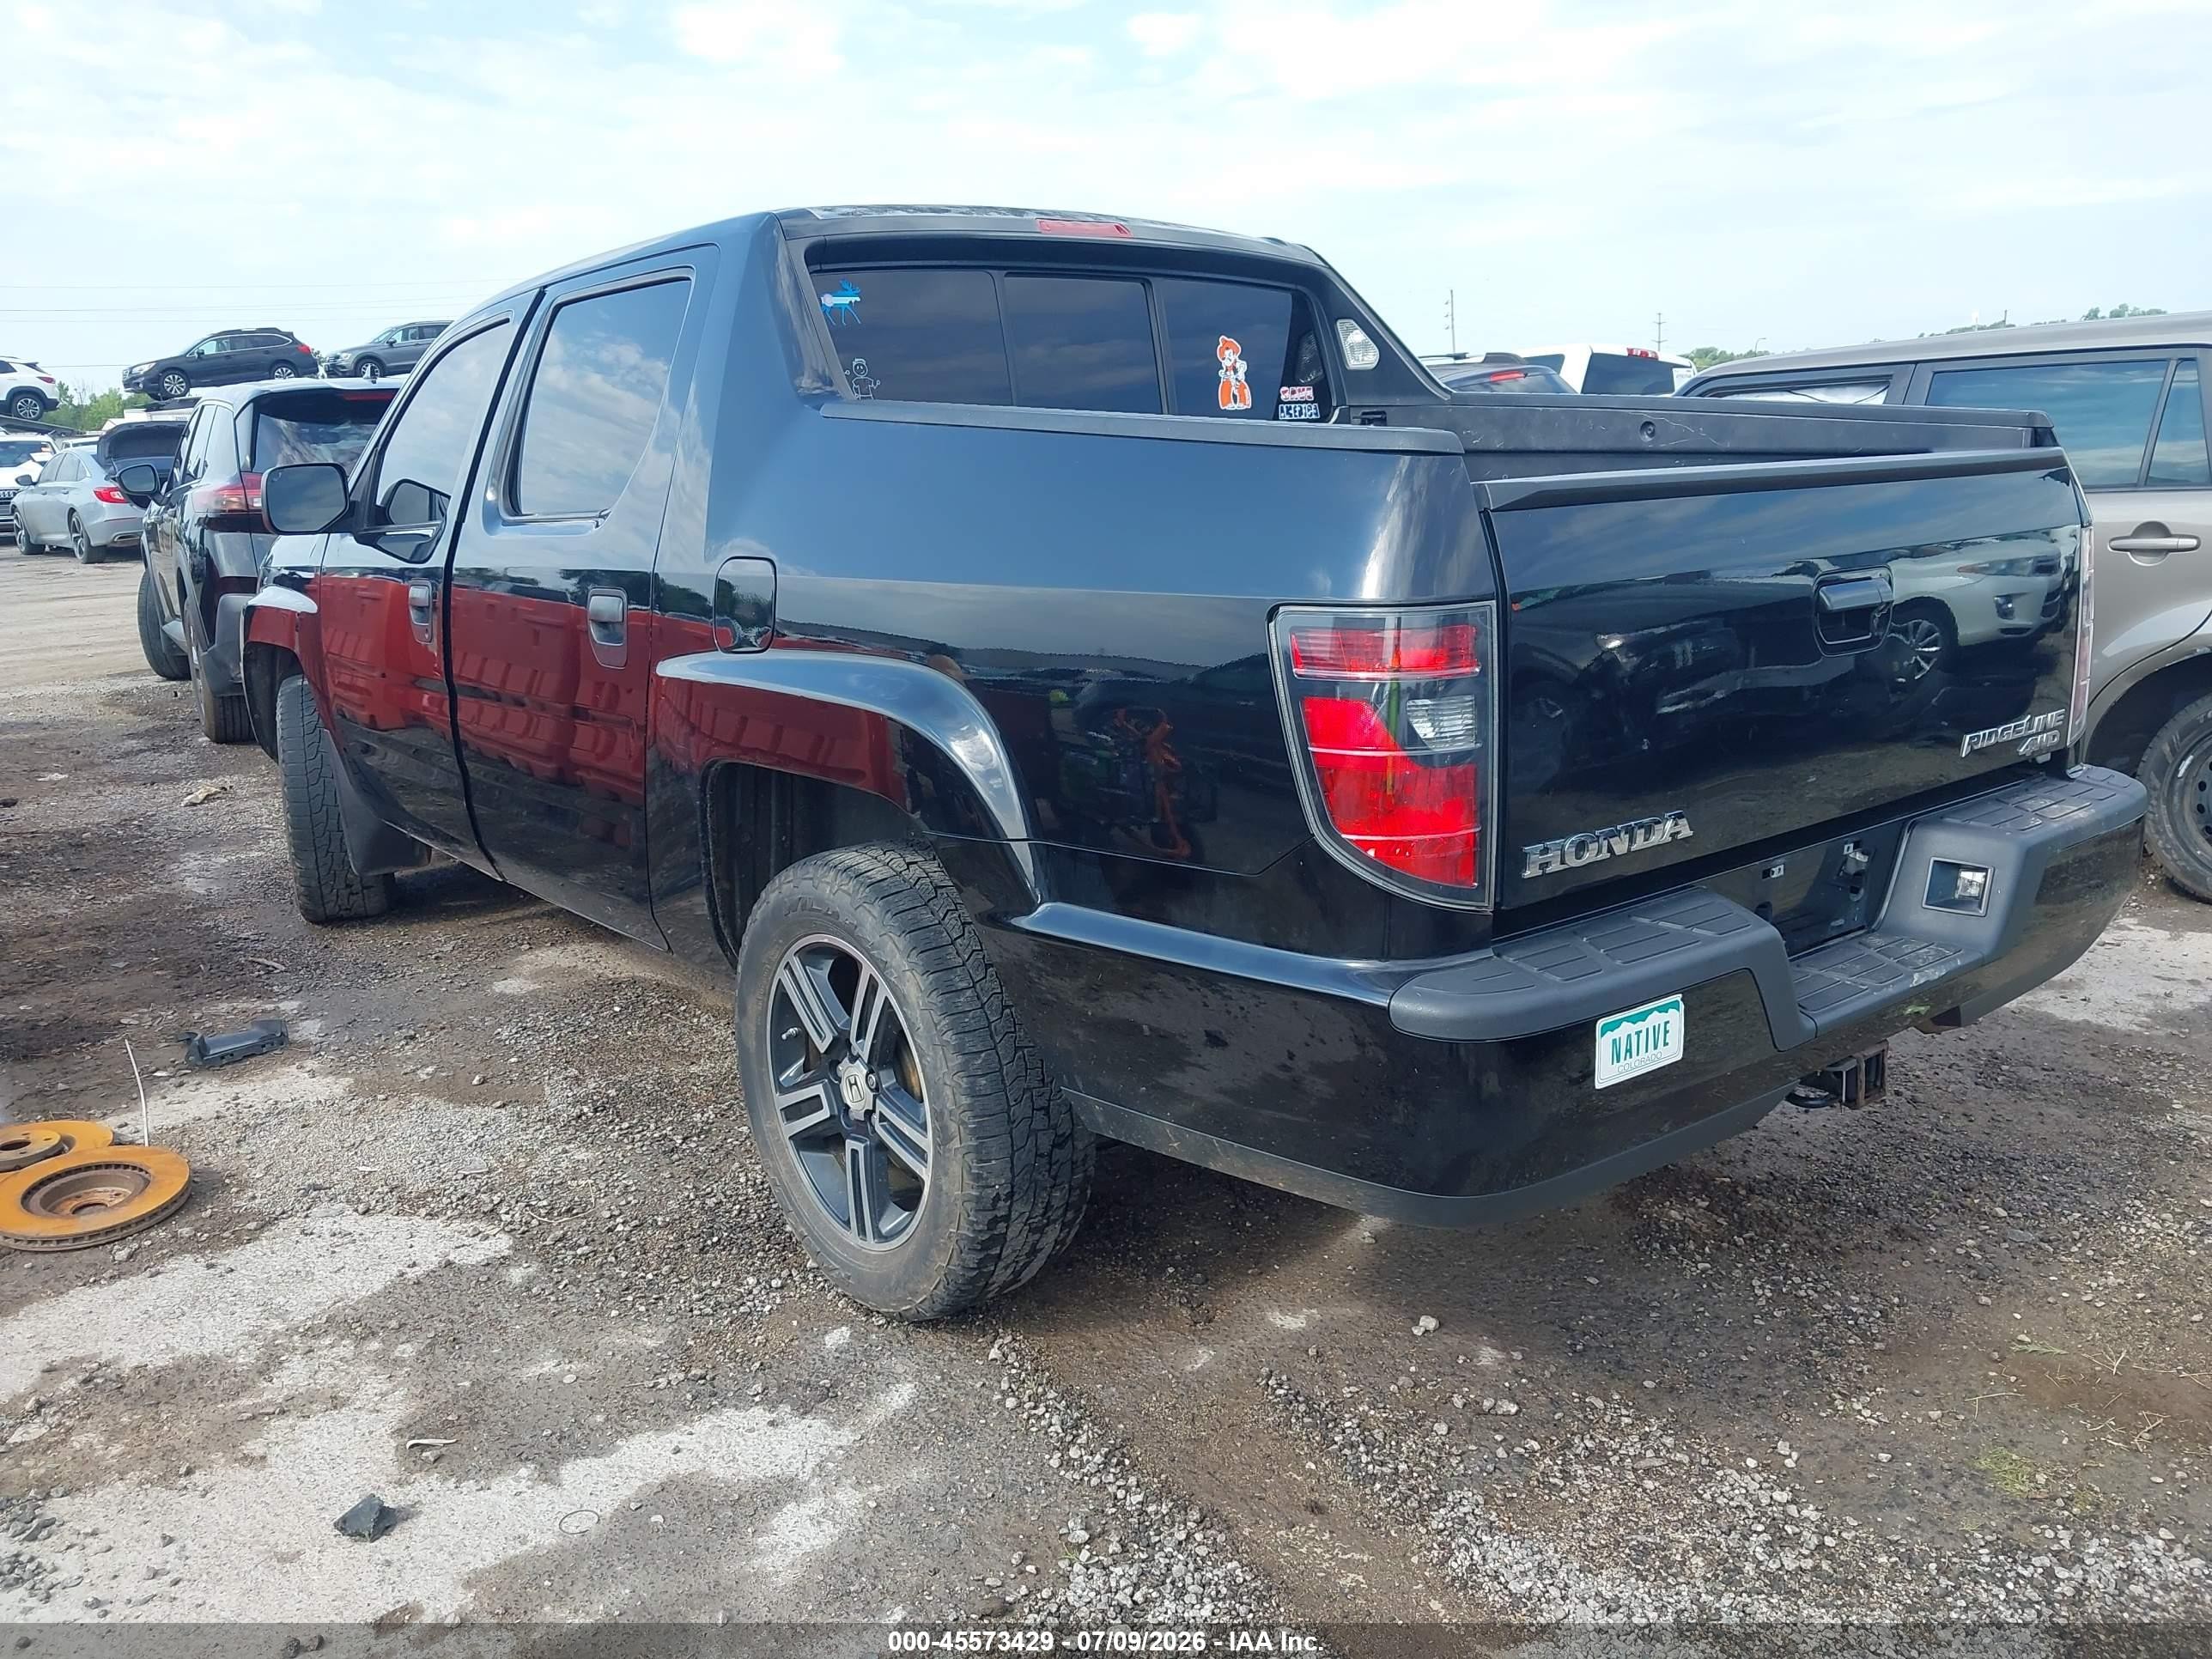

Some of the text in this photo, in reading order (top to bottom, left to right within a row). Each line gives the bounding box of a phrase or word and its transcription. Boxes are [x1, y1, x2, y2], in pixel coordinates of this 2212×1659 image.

[1279, 403, 1320, 420] AMERICA
[1960, 708, 2066, 757] RIDGELINE
[2016, 729, 2061, 757] 4WD
[1521, 810, 1694, 879] HONDA
[1611, 1019, 1670, 1066] NATIVE
[1617, 1050, 1662, 1073] COLORADO
